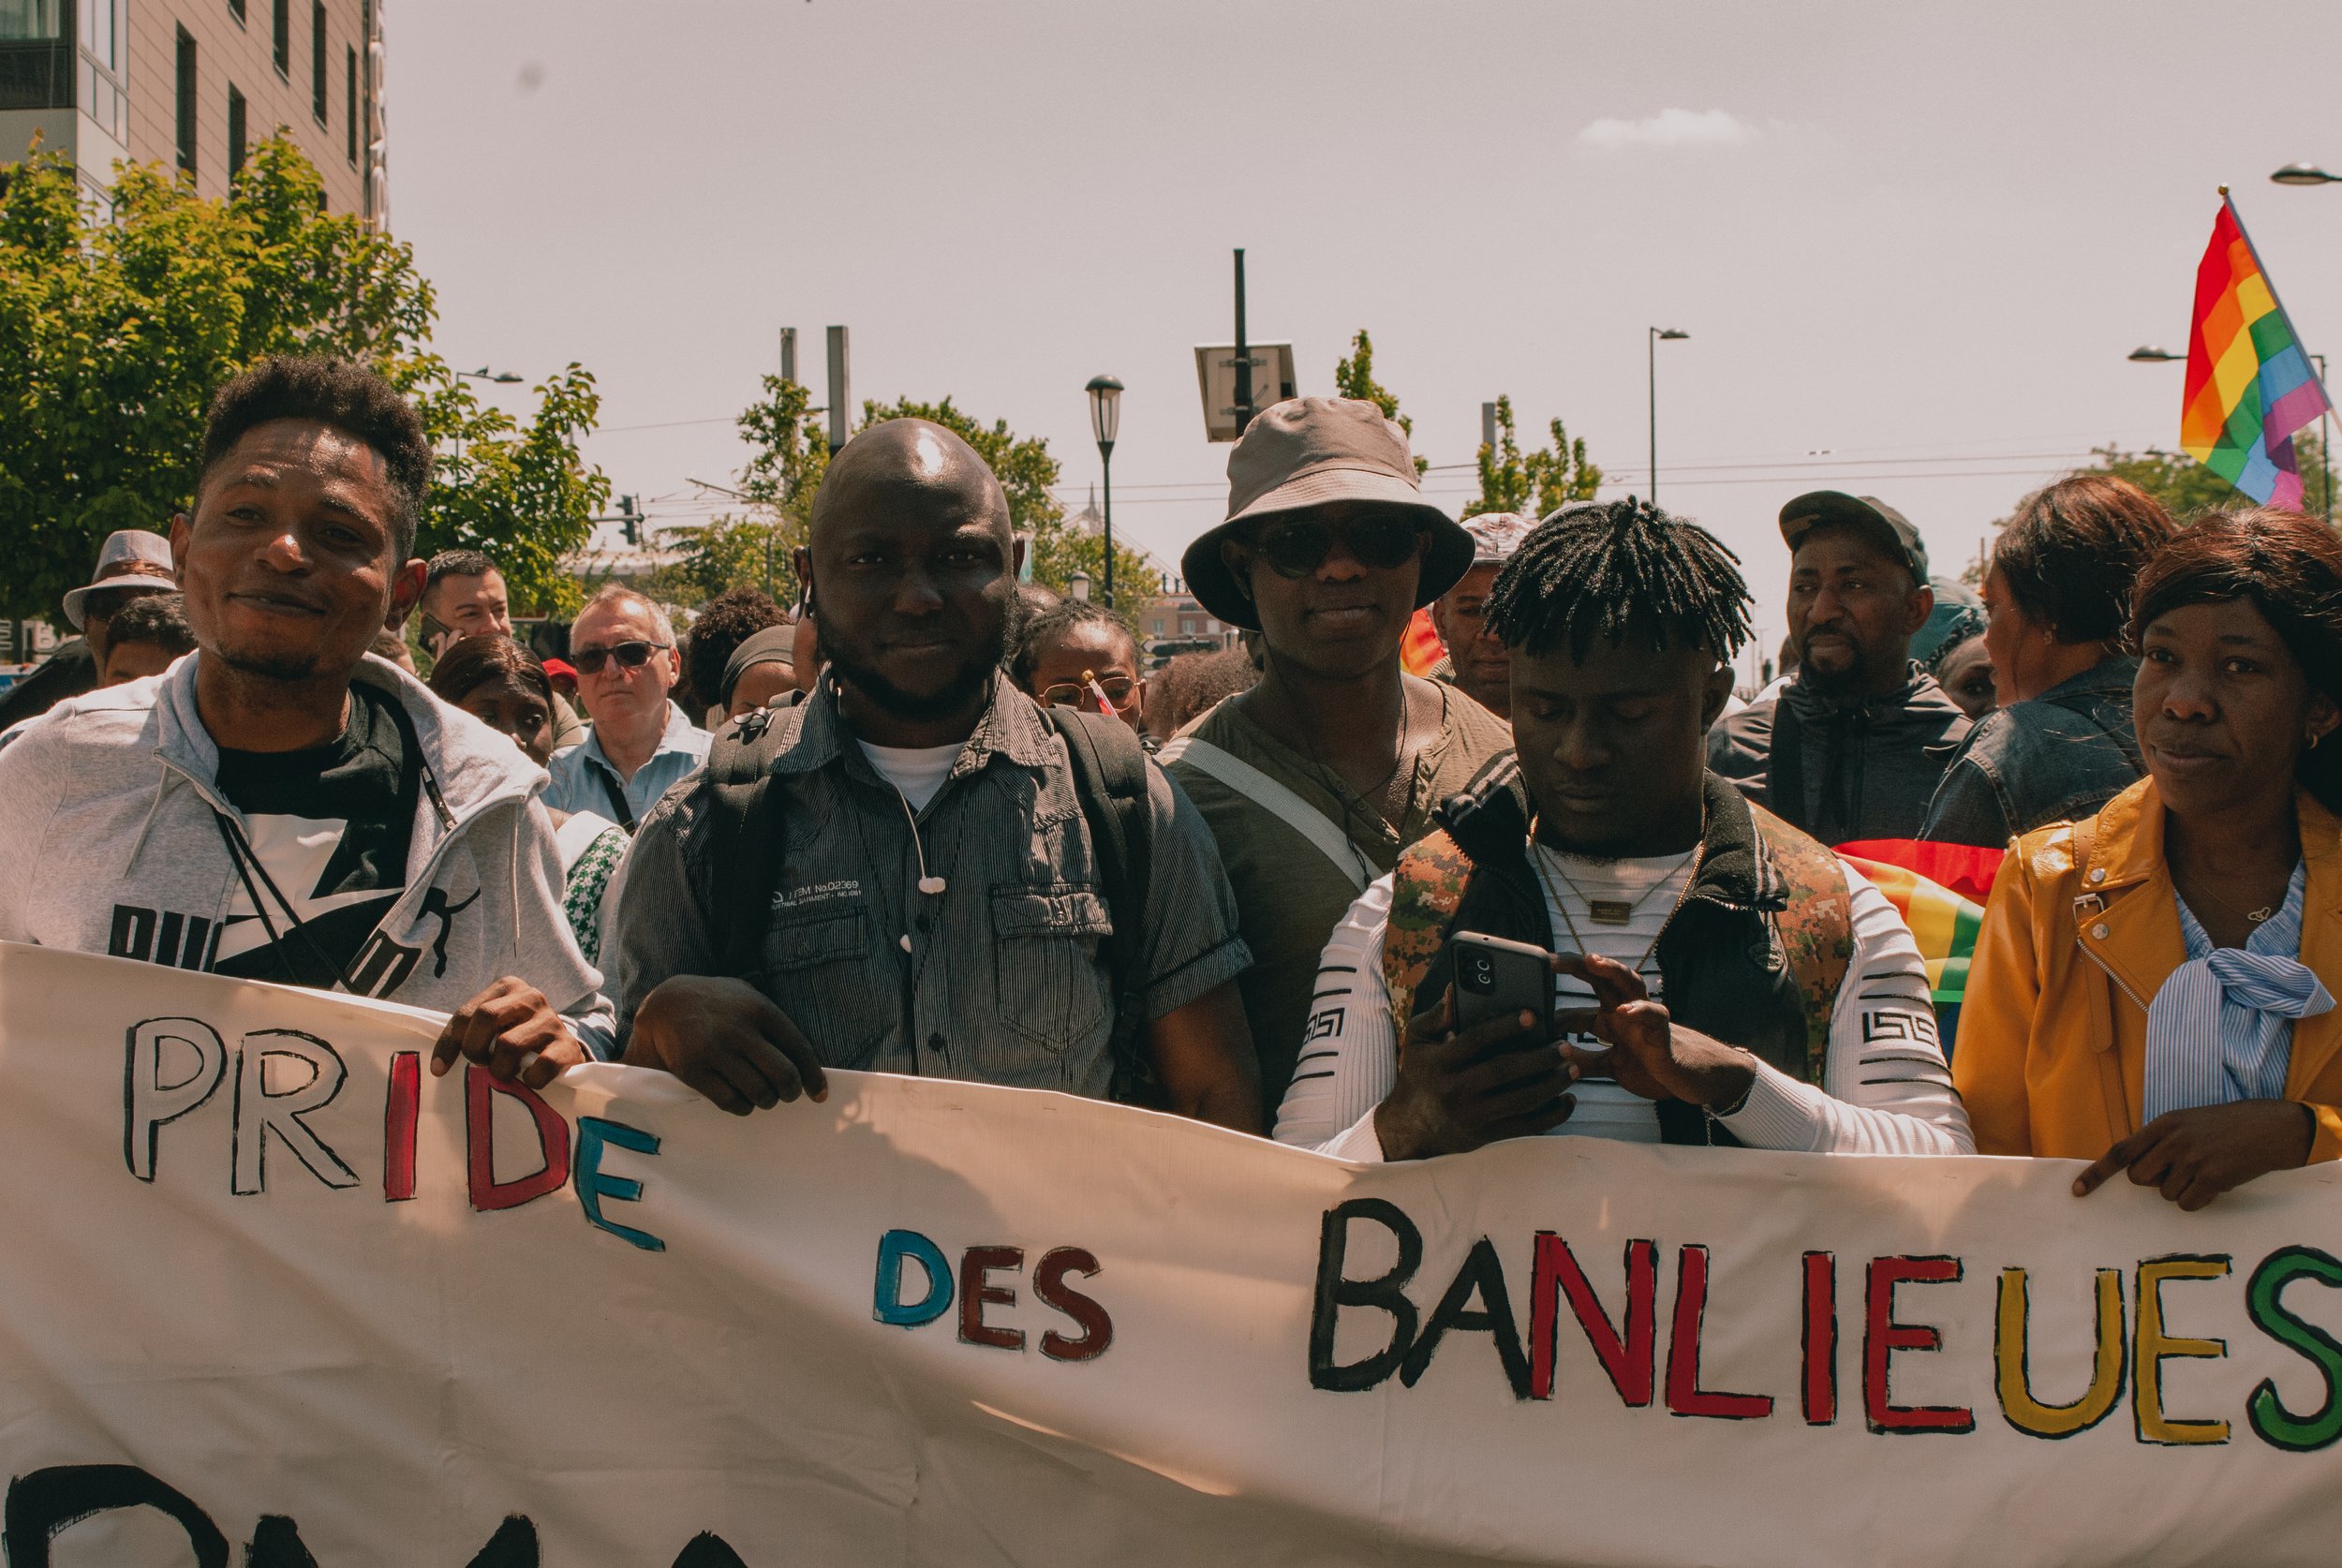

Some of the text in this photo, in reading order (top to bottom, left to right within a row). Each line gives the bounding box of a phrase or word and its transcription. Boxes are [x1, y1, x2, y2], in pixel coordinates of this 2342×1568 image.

[124, 1016, 2342, 1453] PRIDE DES BANLIEUES
